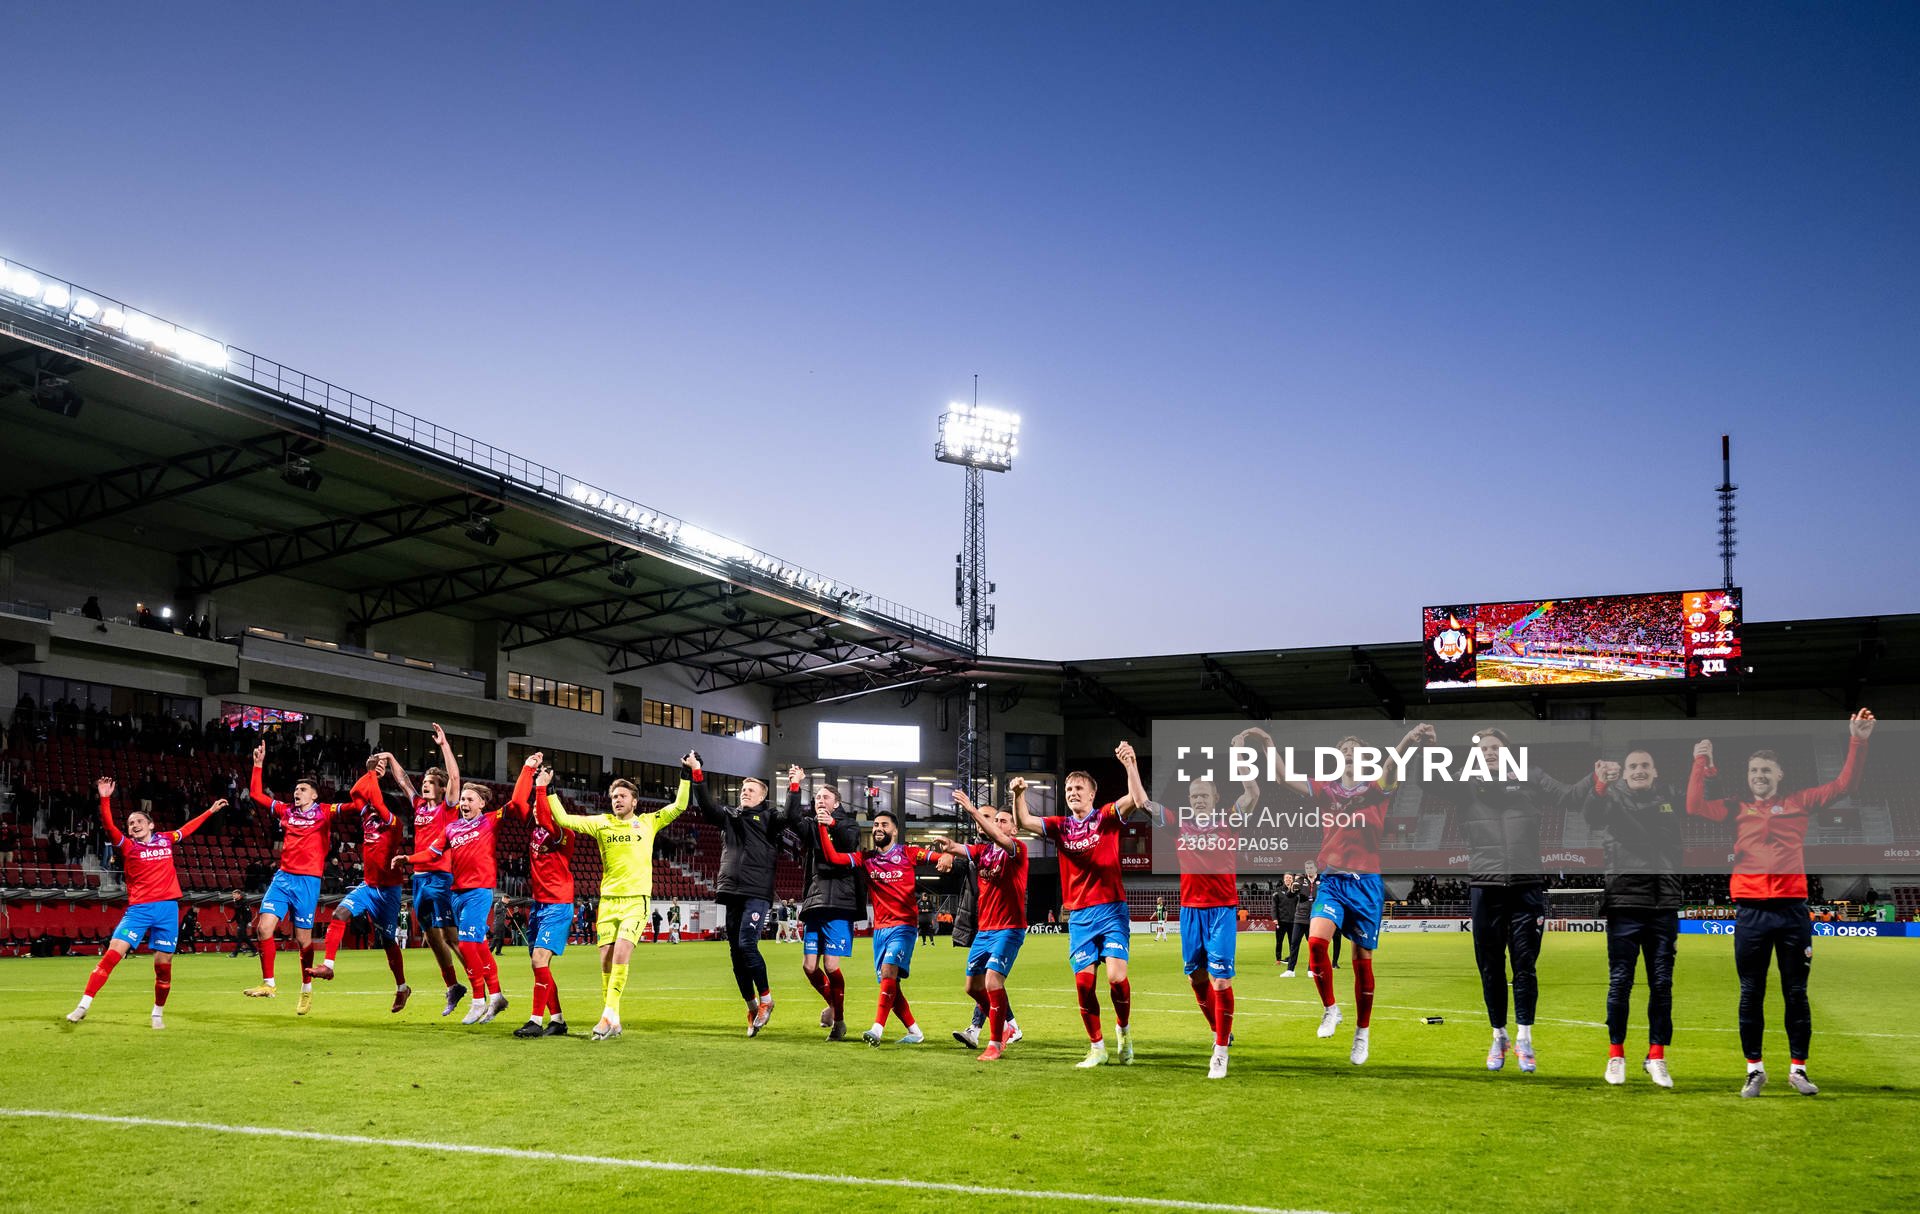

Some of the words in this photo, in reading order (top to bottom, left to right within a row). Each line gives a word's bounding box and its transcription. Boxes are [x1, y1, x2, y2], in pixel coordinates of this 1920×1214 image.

[1692, 597, 1702, 608] 2
[1691, 630, 1734, 643] 95:23
[1702, 659, 1727, 673] XXL
[606, 833, 631, 844] akea
[1063, 838, 1090, 850] akea
[1883, 848, 1910, 857] akea
[1121, 856, 1141, 865] akea
[1253, 855, 1274, 864] akea
[1836, 926, 1878, 937] OBOS
